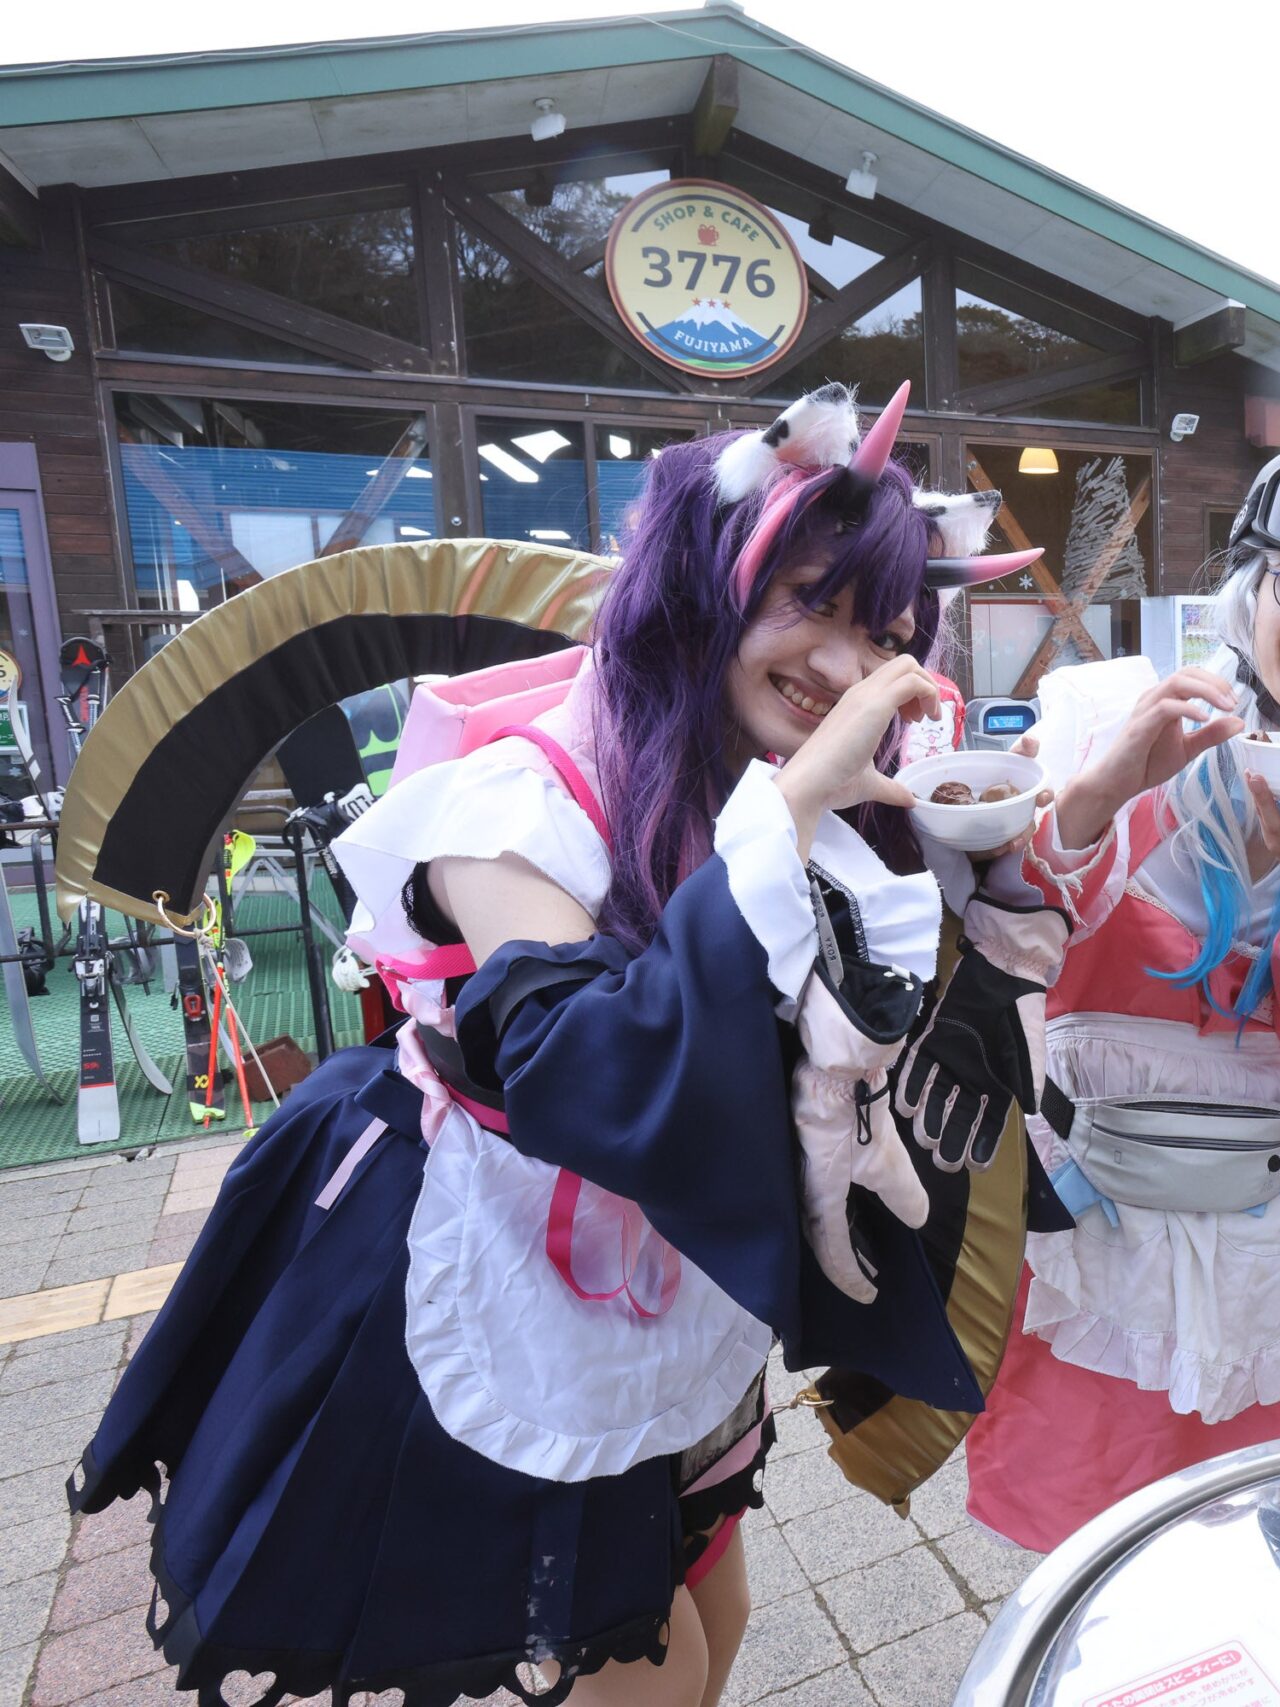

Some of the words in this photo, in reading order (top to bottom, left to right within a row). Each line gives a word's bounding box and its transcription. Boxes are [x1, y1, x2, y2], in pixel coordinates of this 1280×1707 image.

[653, 205, 696, 231] SHOP
[703, 206, 714, 218] &
[721, 209, 760, 242] CAFE
[641, 246, 776, 298] 3776
[674, 329, 753, 353] FUJIYAMA
